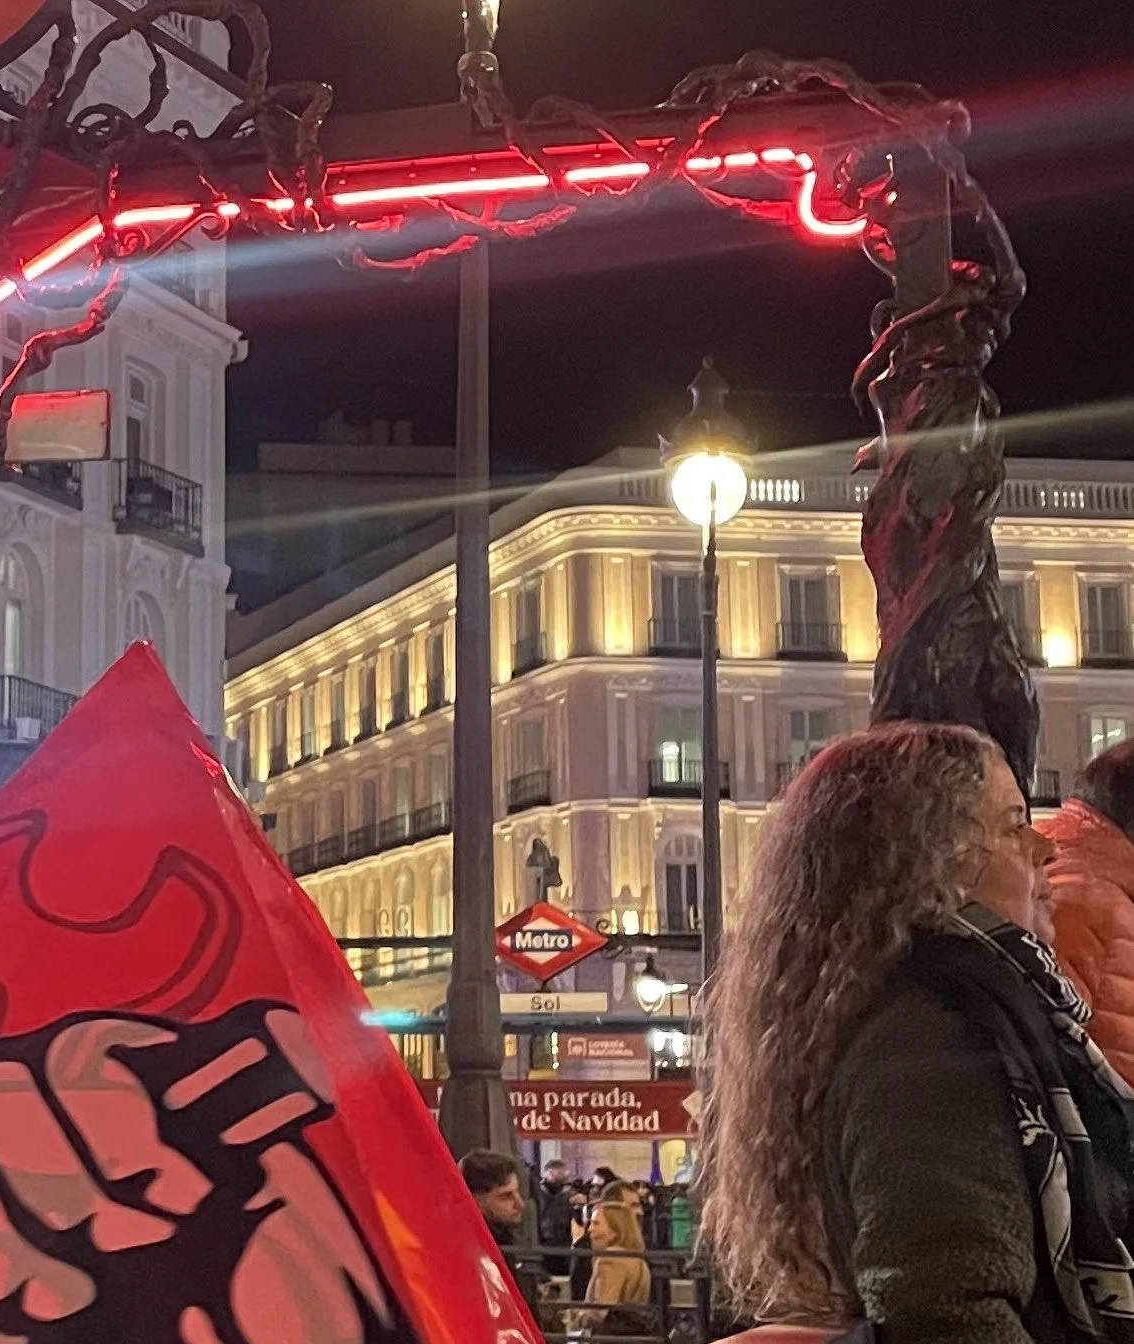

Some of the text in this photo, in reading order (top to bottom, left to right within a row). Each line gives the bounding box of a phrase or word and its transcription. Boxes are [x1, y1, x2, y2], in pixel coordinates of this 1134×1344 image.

[515, 929, 569, 951] Metro
[530, 995, 561, 1012] Sol
[544, 1087, 641, 1110] parada,
[521, 1110, 660, 1132] de Navidad
